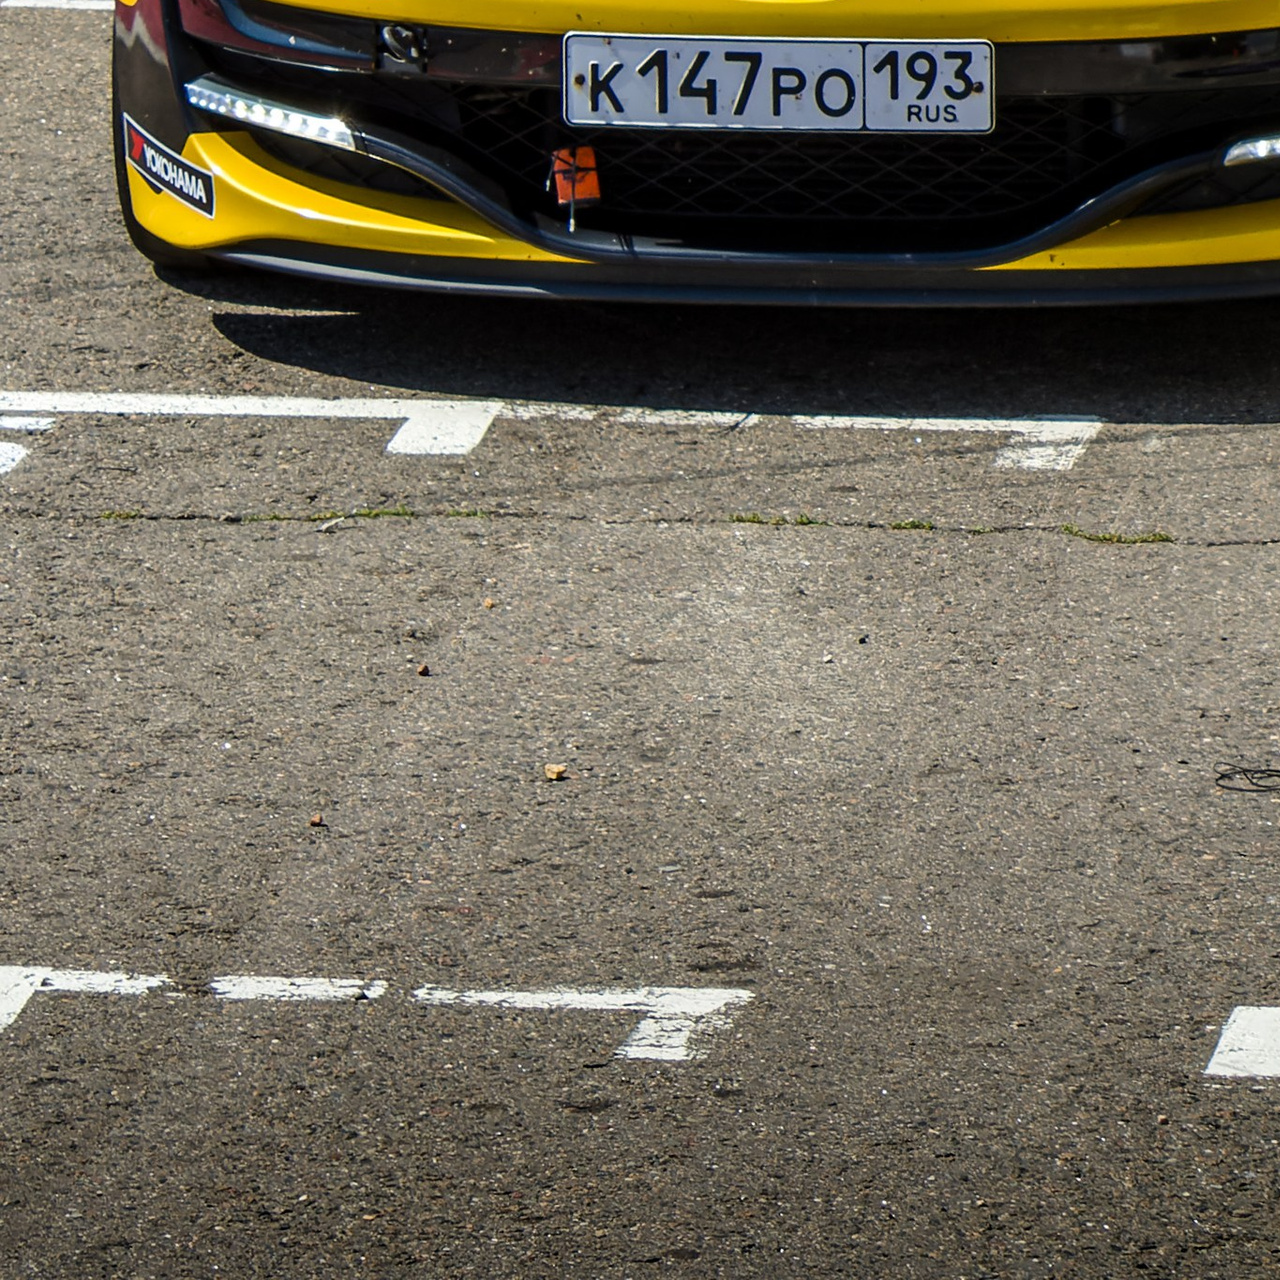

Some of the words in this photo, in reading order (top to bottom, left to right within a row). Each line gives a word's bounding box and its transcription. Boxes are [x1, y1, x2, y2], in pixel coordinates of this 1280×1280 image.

[872, 49, 976, 101] 193
[906, 104, 958, 123] RUS
[143, 142, 207, 204] YOKOHAMA
